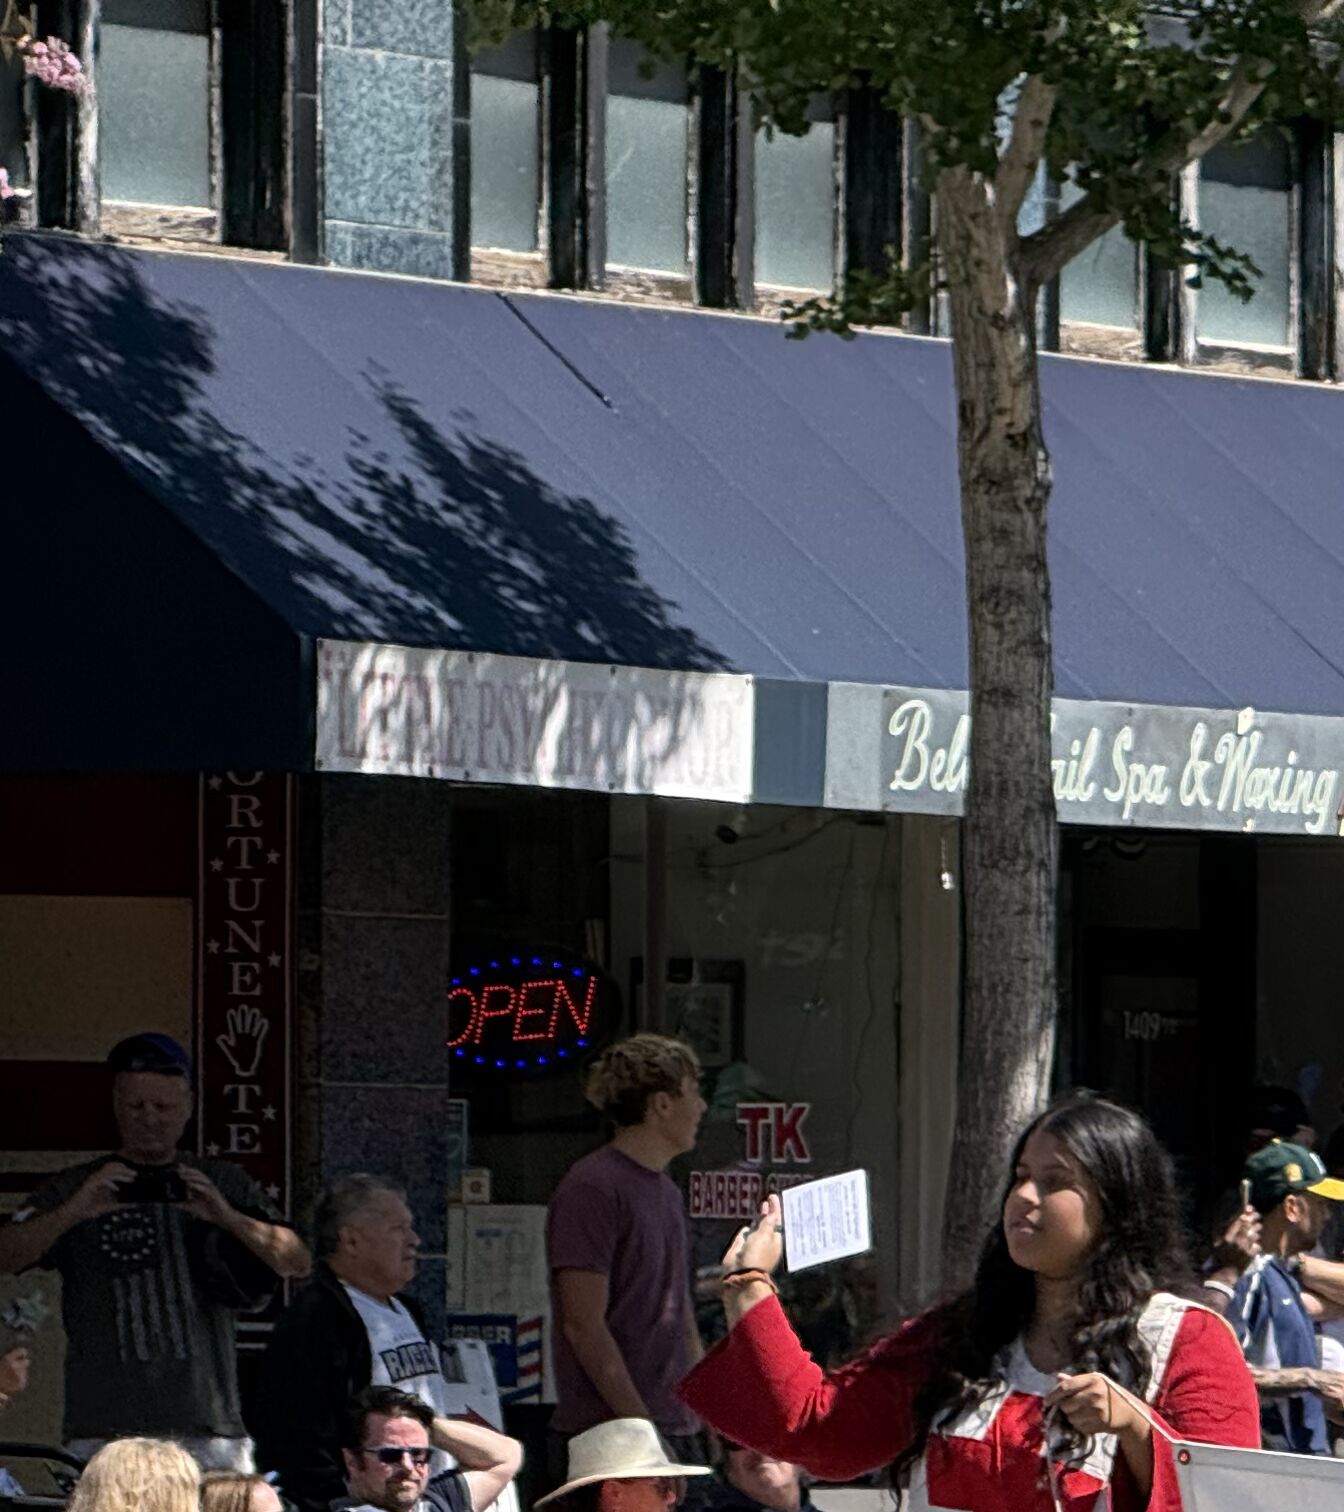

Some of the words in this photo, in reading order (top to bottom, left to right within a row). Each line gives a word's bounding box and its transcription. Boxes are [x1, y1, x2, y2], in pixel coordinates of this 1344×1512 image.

[888, 699, 971, 793] Bel
[1103, 725, 1170, 820] Spa
[1179, 721, 1214, 807] &
[1214, 730, 1340, 835] Waxing
[447, 975, 599, 1046] OPEN
[1122, 1010, 1161, 1040] 1409
[736, 1102, 812, 1163] TK
[689, 1171, 763, 1219] BARBER
